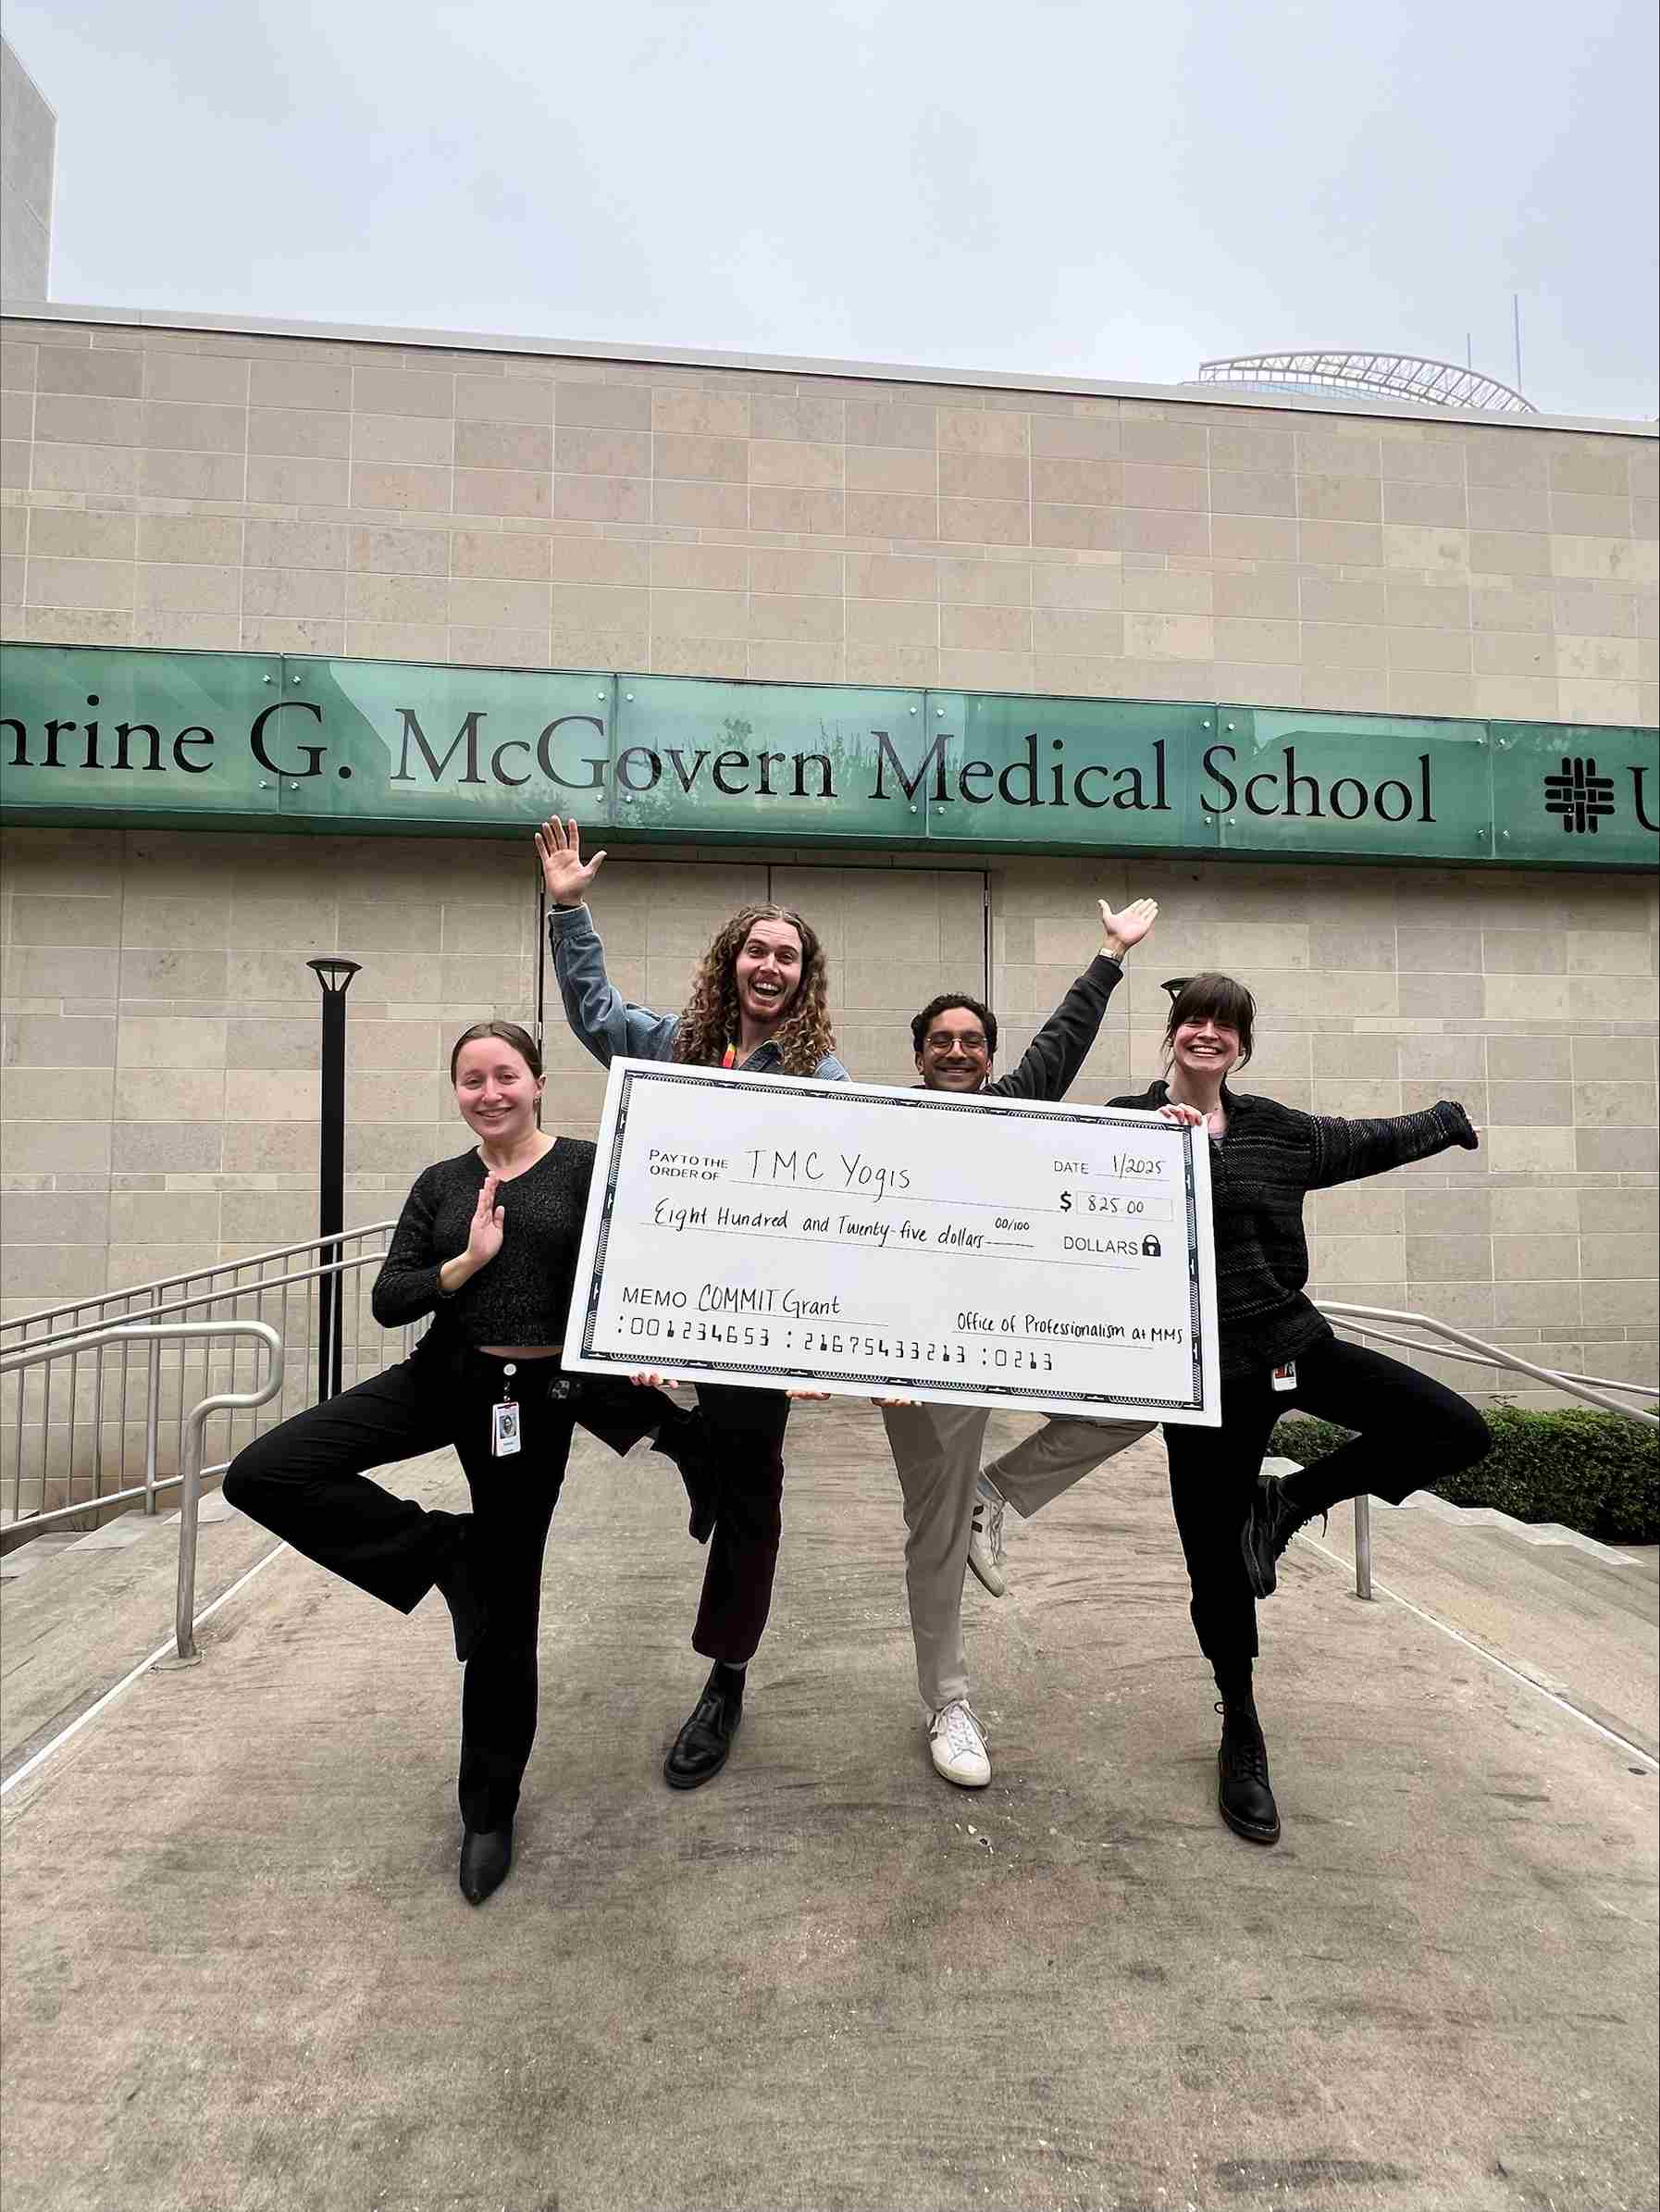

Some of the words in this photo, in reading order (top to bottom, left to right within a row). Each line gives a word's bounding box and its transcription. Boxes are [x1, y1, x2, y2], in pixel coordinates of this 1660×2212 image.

[249, 702, 352, 777] G.
[390, 708, 837, 799] McGovern
[867, 731, 1171, 811] Medical
[1199, 744, 1437, 823] School
[649, 1149, 679, 1162] PAY
[681, 1155, 700, 1166] TO
[702, 1157, 729, 1170] THE
[1054, 1161, 1089, 1174] DATE
[1112, 1153, 1167, 1179] 1/2025
[650, 1165, 699, 1179] ORDER
[701, 1170, 722, 1181] OF
[744, 1149, 824, 1182] TMC
[840, 1153, 911, 1203] Yogis
[1059, 1190, 1072, 1212] $
[654, 1198, 708, 1232] Eight
[717, 1206, 788, 1228] Hundred
[802, 1216, 830, 1232] and
[838, 1215, 926, 1248] Twenty-five
[937, 1224, 985, 1249] dollars
[994, 1217, 1031, 1231] 00/100
[1063, 1236, 1138, 1256] DOLLARS
[622, 1286, 687, 1308] MEMO
[698, 1284, 779, 1312] COMMIT
[782, 1289, 842, 1318] Grant
[957, 1312, 994, 1332] Office
[1000, 1315, 1016, 1333] of
[1025, 1314, 1124, 1338] Professionalism
[1132, 1328, 1146, 1340] at
[1151, 1328, 1183, 1344] MMS
